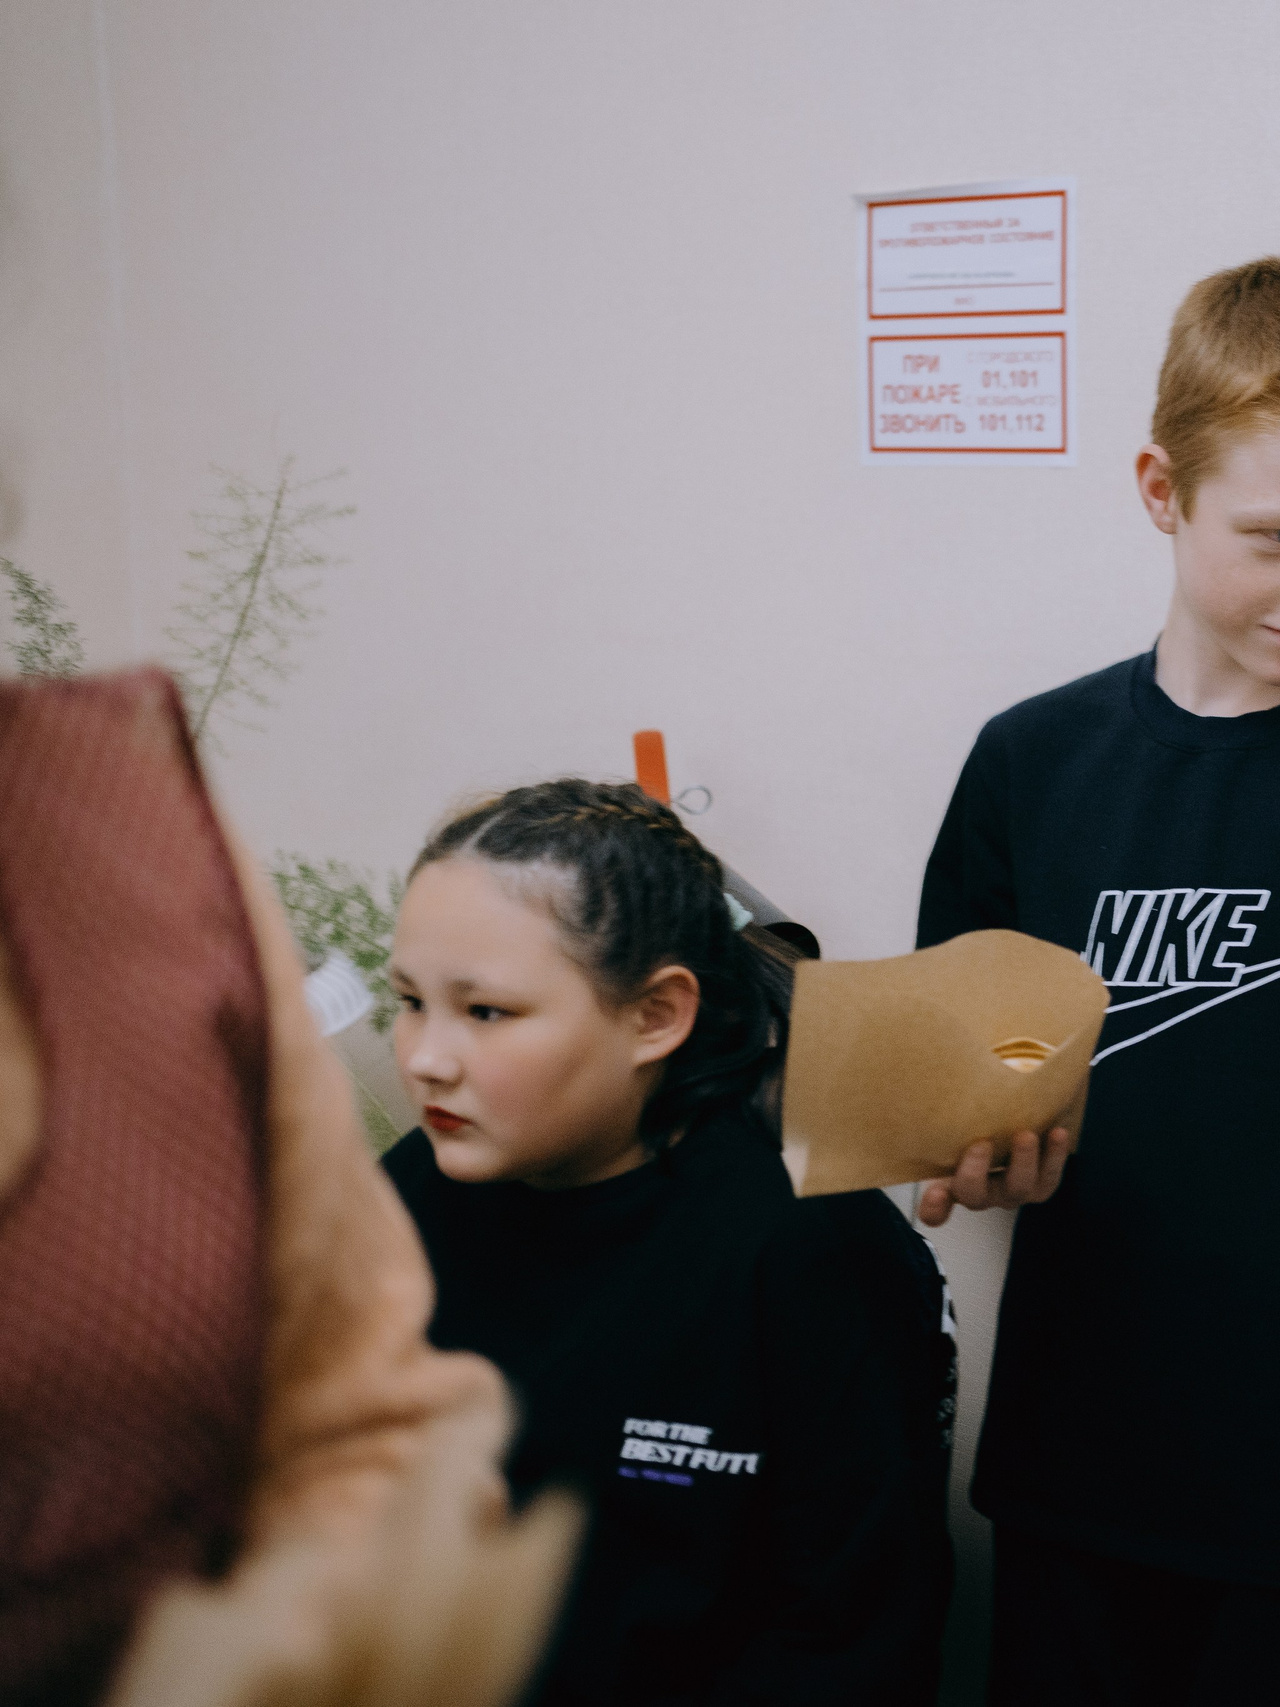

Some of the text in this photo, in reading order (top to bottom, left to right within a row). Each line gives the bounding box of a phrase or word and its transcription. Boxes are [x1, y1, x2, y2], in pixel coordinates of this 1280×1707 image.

[903, 354, 940, 373] ПРИ
[883, 384, 961, 404] ПОЖАРЕ
[880, 414, 966, 433] ЗВОНИТЬ
[1080, 888, 1271, 986] NIKE
[623, 1418, 713, 1445] FOR THE
[620, 1437, 692, 1466] BEST
